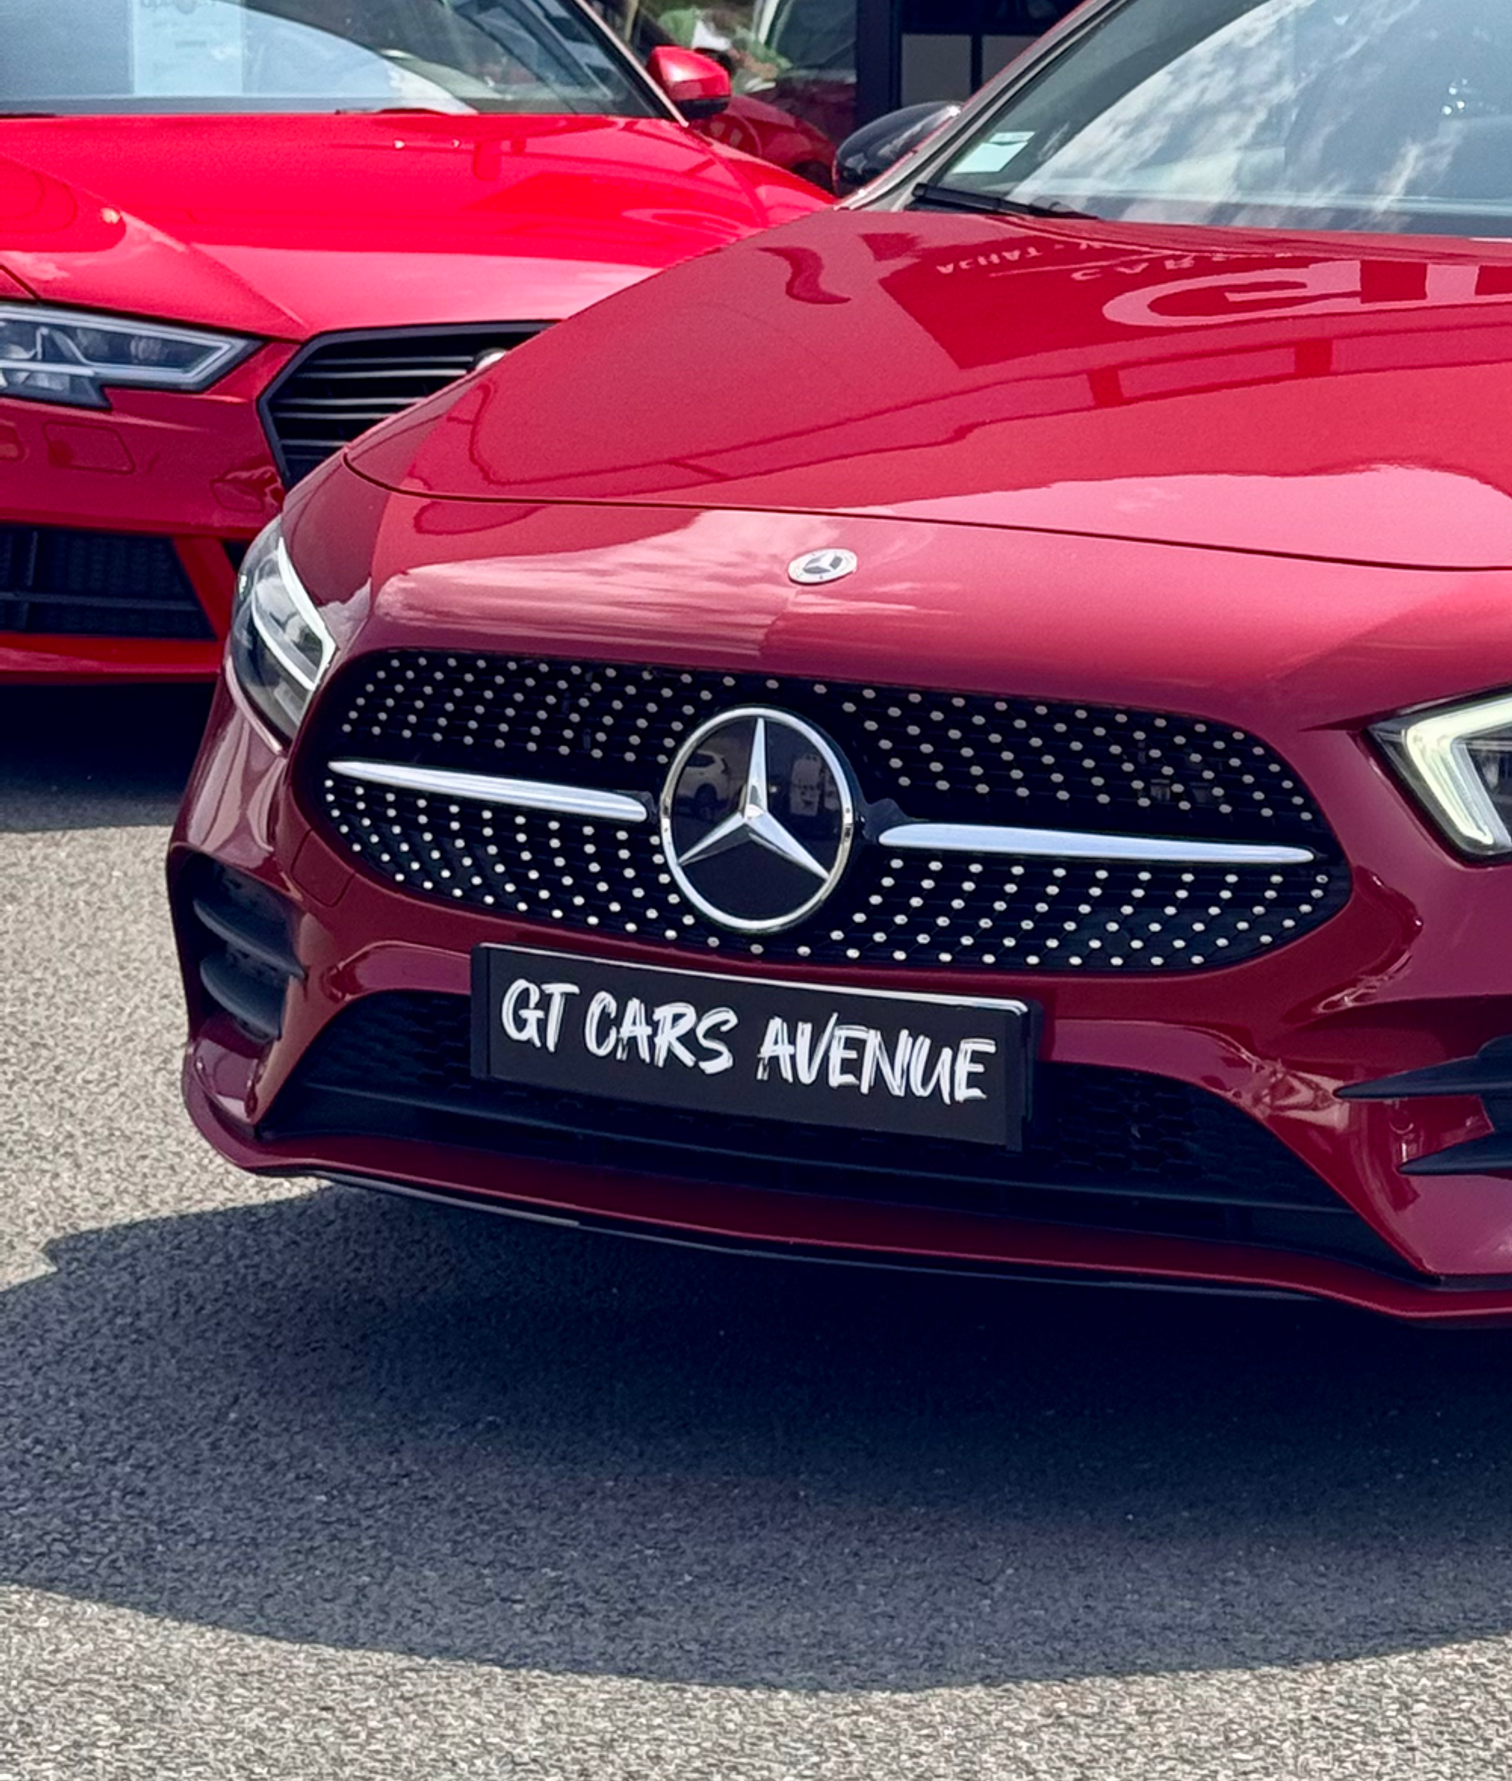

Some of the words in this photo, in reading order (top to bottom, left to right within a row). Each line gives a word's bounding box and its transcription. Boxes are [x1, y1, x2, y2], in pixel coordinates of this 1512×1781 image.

[501, 979, 579, 1052] GT
[584, 991, 738, 1075] CARS
[757, 1013, 996, 1105] AVENUE
